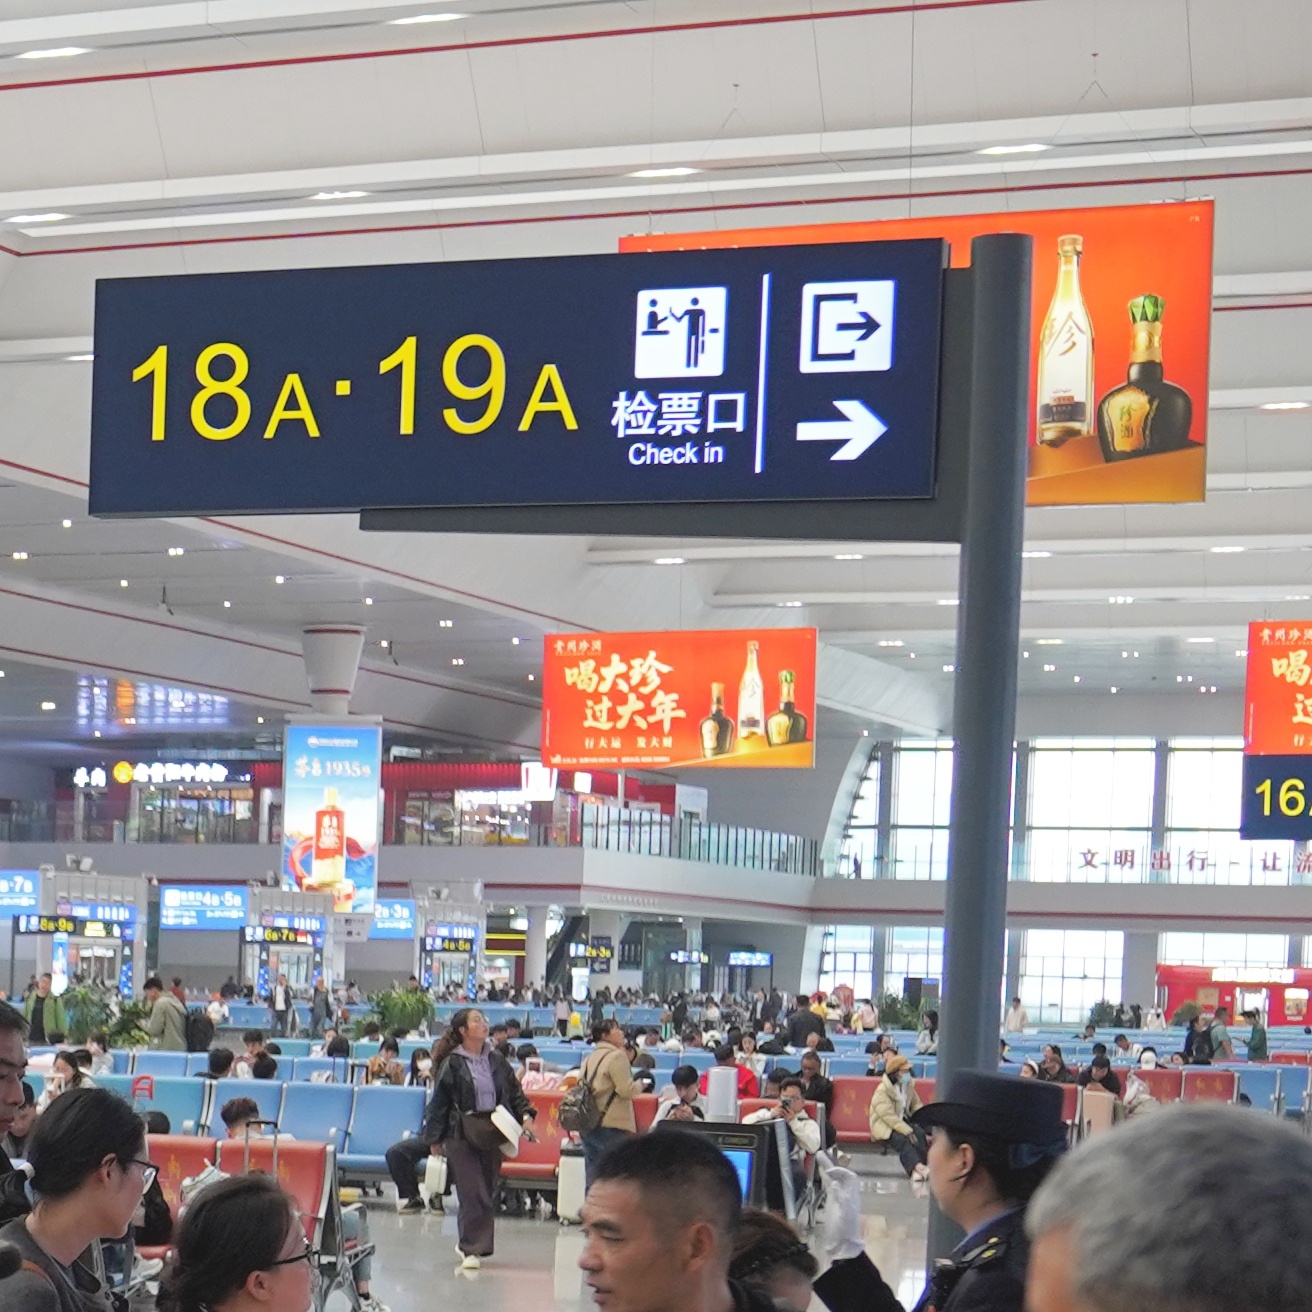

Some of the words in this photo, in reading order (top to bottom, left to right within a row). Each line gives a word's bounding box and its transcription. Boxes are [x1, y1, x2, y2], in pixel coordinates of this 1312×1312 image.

[611, 390, 746, 440] 检票口
[628, 442, 693, 467] Check
[702, 442, 724, 465] in
[564, 650, 675, 693] 喝大珍
[1271, 649, 1312, 687] 喝
[583, 690, 687, 734] 过大年
[1255, 778, 1312, 817] 16
[1078, 847, 1209, 872] 文明出行
